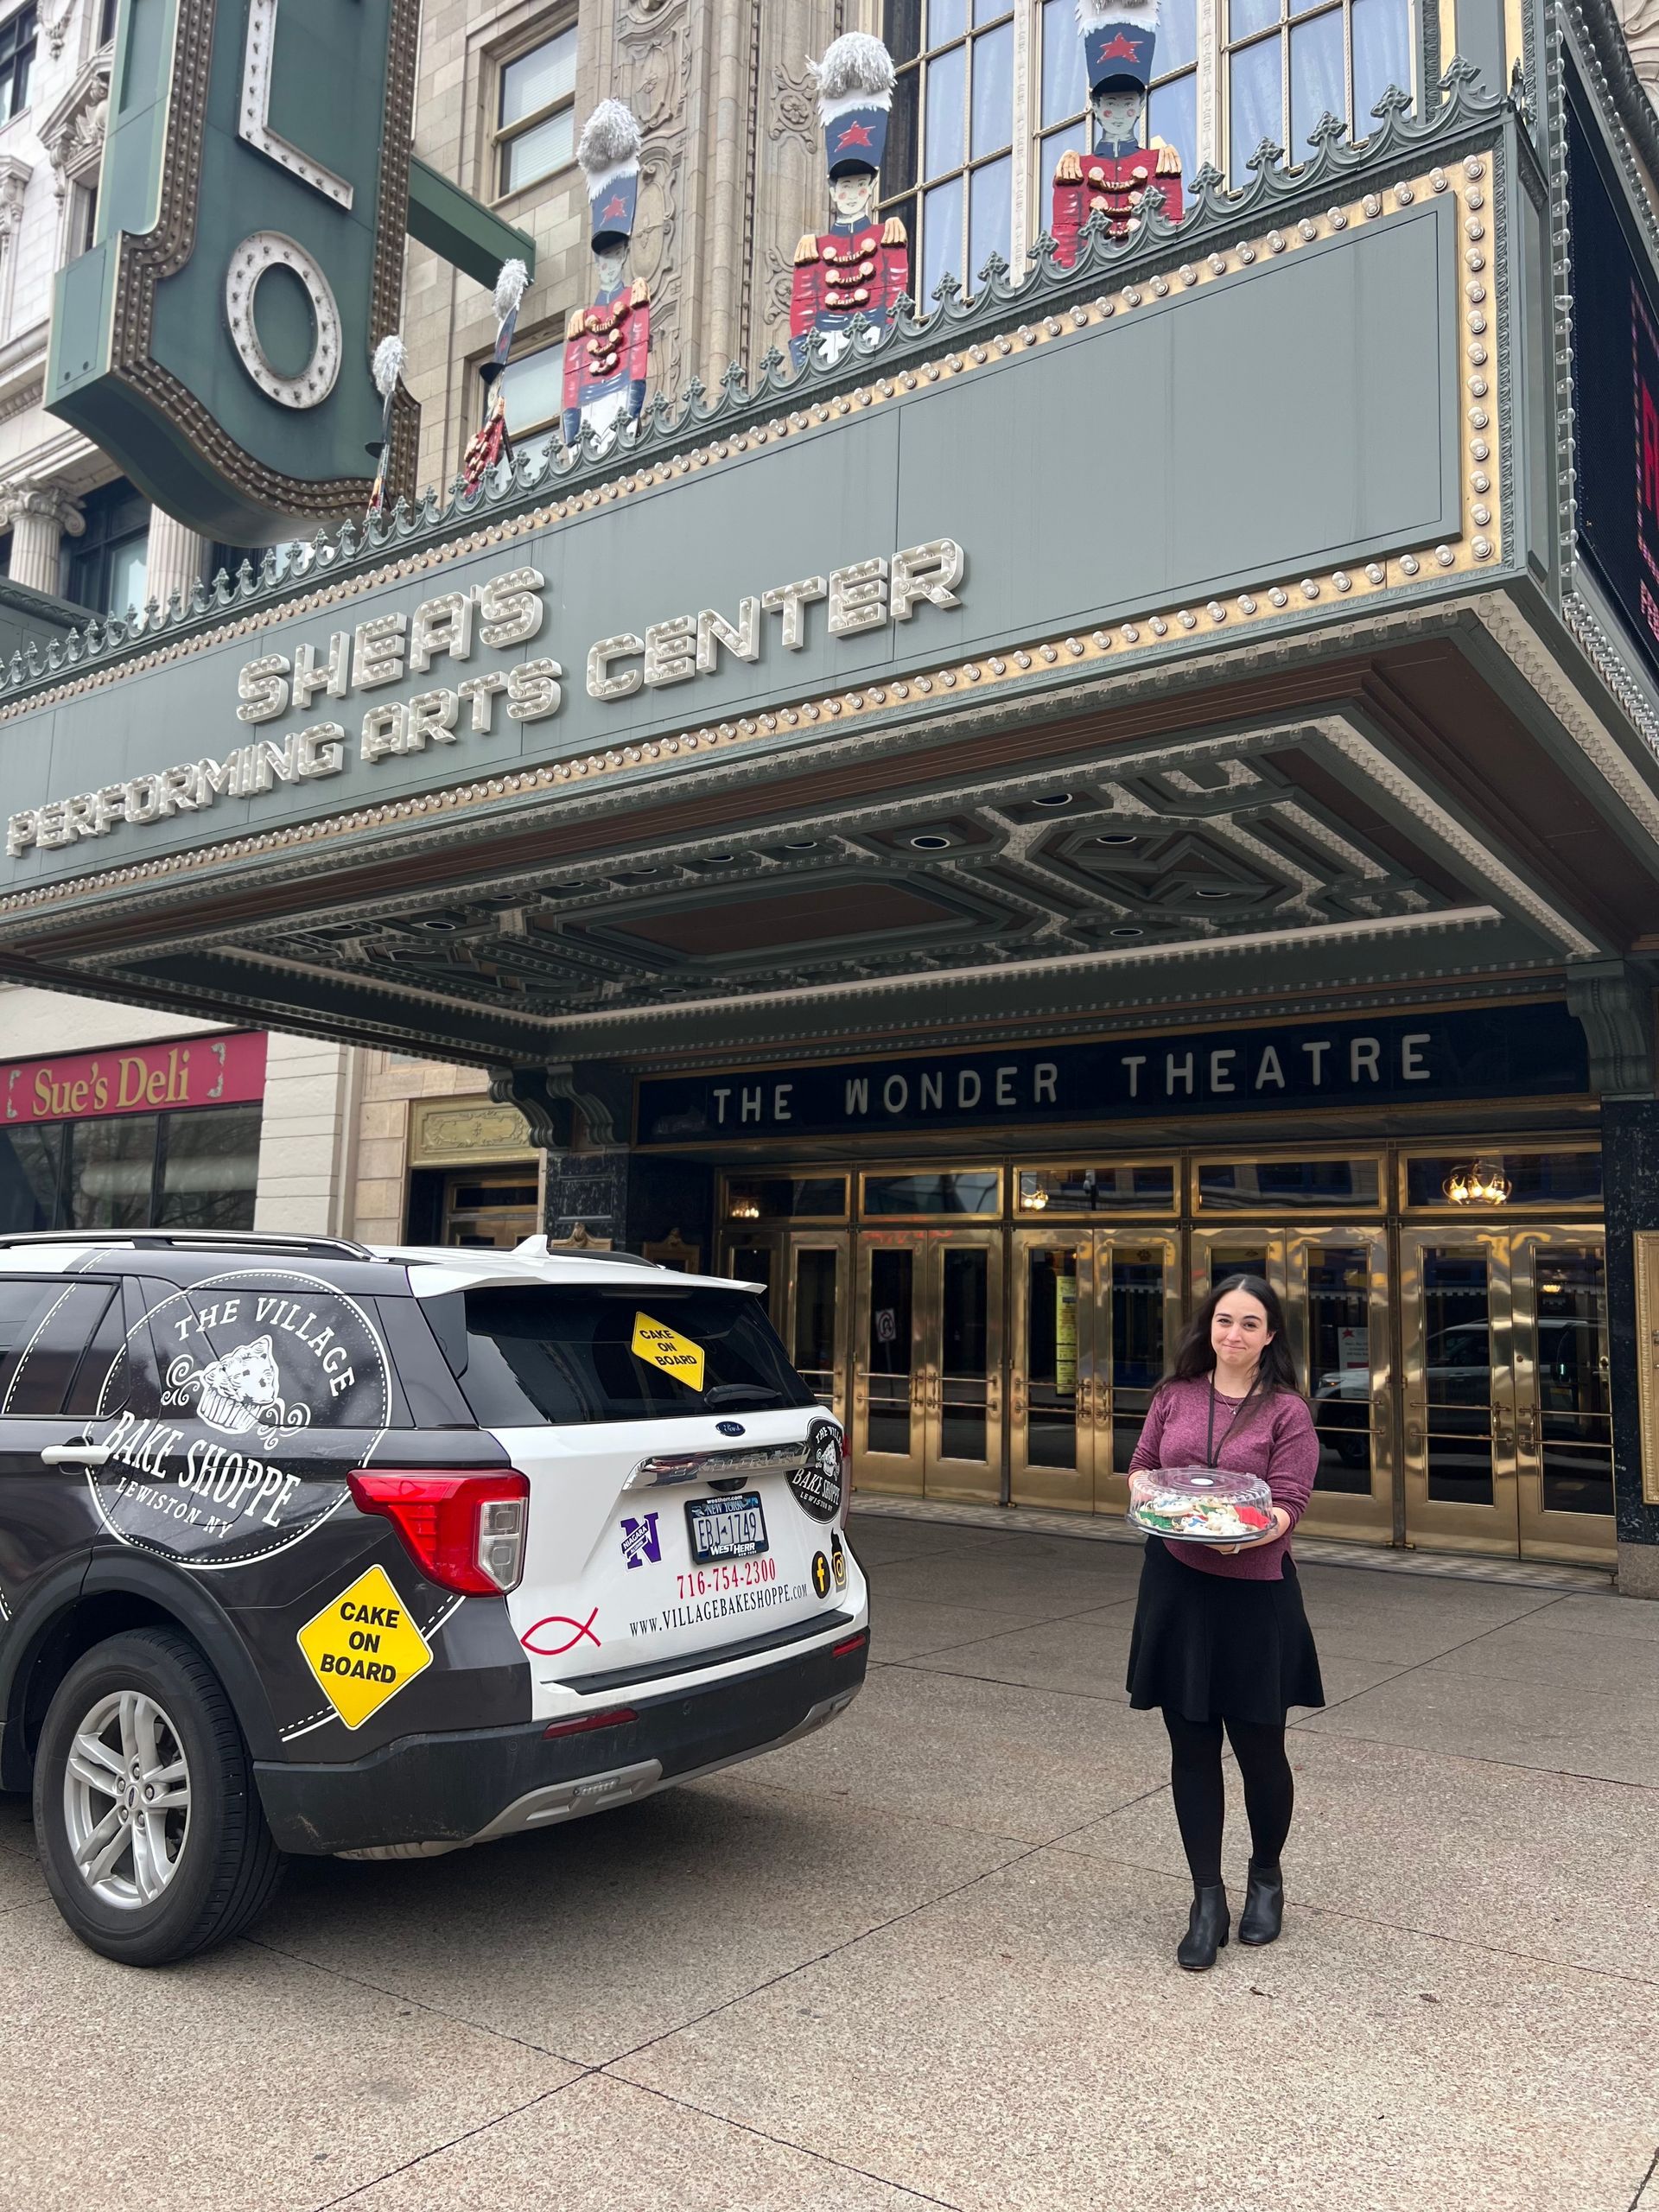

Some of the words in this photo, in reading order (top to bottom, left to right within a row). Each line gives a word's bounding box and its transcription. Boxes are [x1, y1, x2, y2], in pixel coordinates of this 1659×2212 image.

[236, 567, 545, 724] SHEA'S
[6, 721, 345, 858] PERFORMING
[360, 657, 563, 763] ARTS
[587, 537, 965, 702] CENTER
[33, 1062, 109, 1116] Sue's
[116, 1047, 190, 1109] Deli
[713, 1084, 794, 1124] THE
[845, 1062, 1058, 1116] WONDER
[1121, 1033, 1432, 1097] THEATRE
[174, 1298, 241, 1342] THE
[254, 1297, 356, 1398] VILLAGE
[639, 1330, 675, 1339] CAKE
[657, 1342, 677, 1352] ON
[655, 1355, 697, 1365] BOARD
[101, 1410, 185, 1479] BAKE
[178, 1438, 302, 1528] SHOPPE
[791, 1467, 823, 1495] BAKE
[114, 1476, 198, 1524] LEWISTON
[203, 1516, 233, 1540] NY
[705, 1503, 722, 1516] NEW
[622, 1525, 648, 1549] NIAGARA
[677, 1557, 777, 1599] 716-754-2300
[340, 1602, 400, 1629] CAKE
[348, 1630, 380, 1653] ON
[320, 1654, 397, 1683] BOARD
